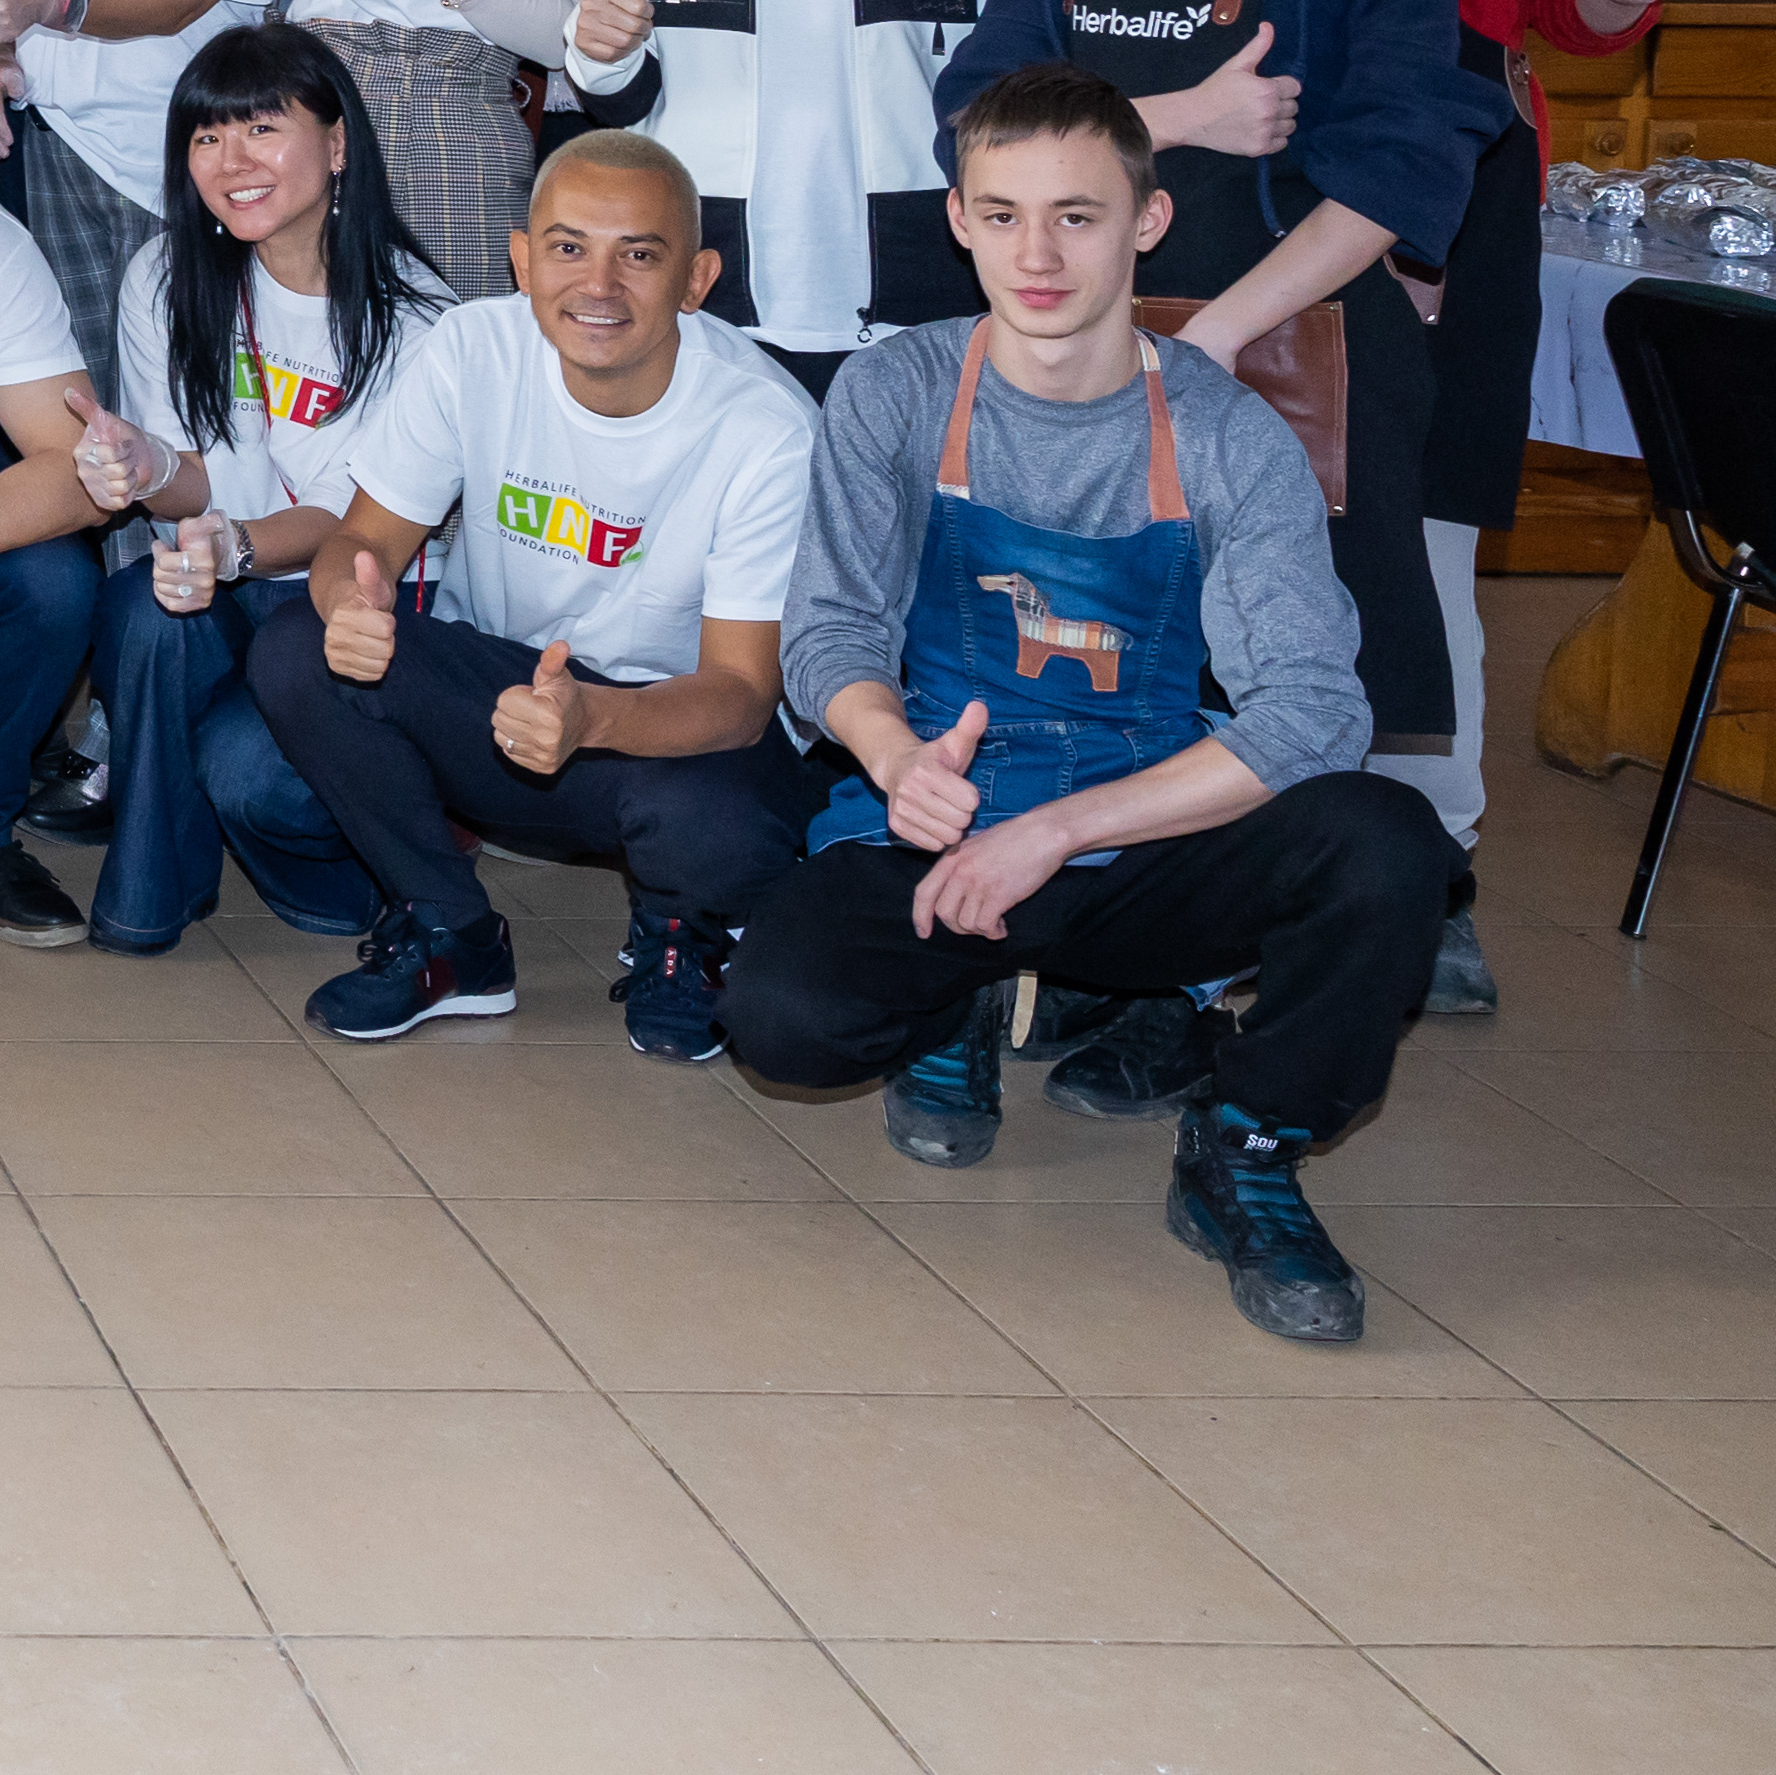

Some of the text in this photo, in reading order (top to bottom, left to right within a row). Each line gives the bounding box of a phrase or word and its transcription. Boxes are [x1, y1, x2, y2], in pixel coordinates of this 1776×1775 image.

[1072, 4, 1194, 40] Herbalife
[283, 357, 340, 383] NUTRITIO
[505, 469, 578, 497] HERBALIFE
[499, 528, 580, 565] OUNDATION
